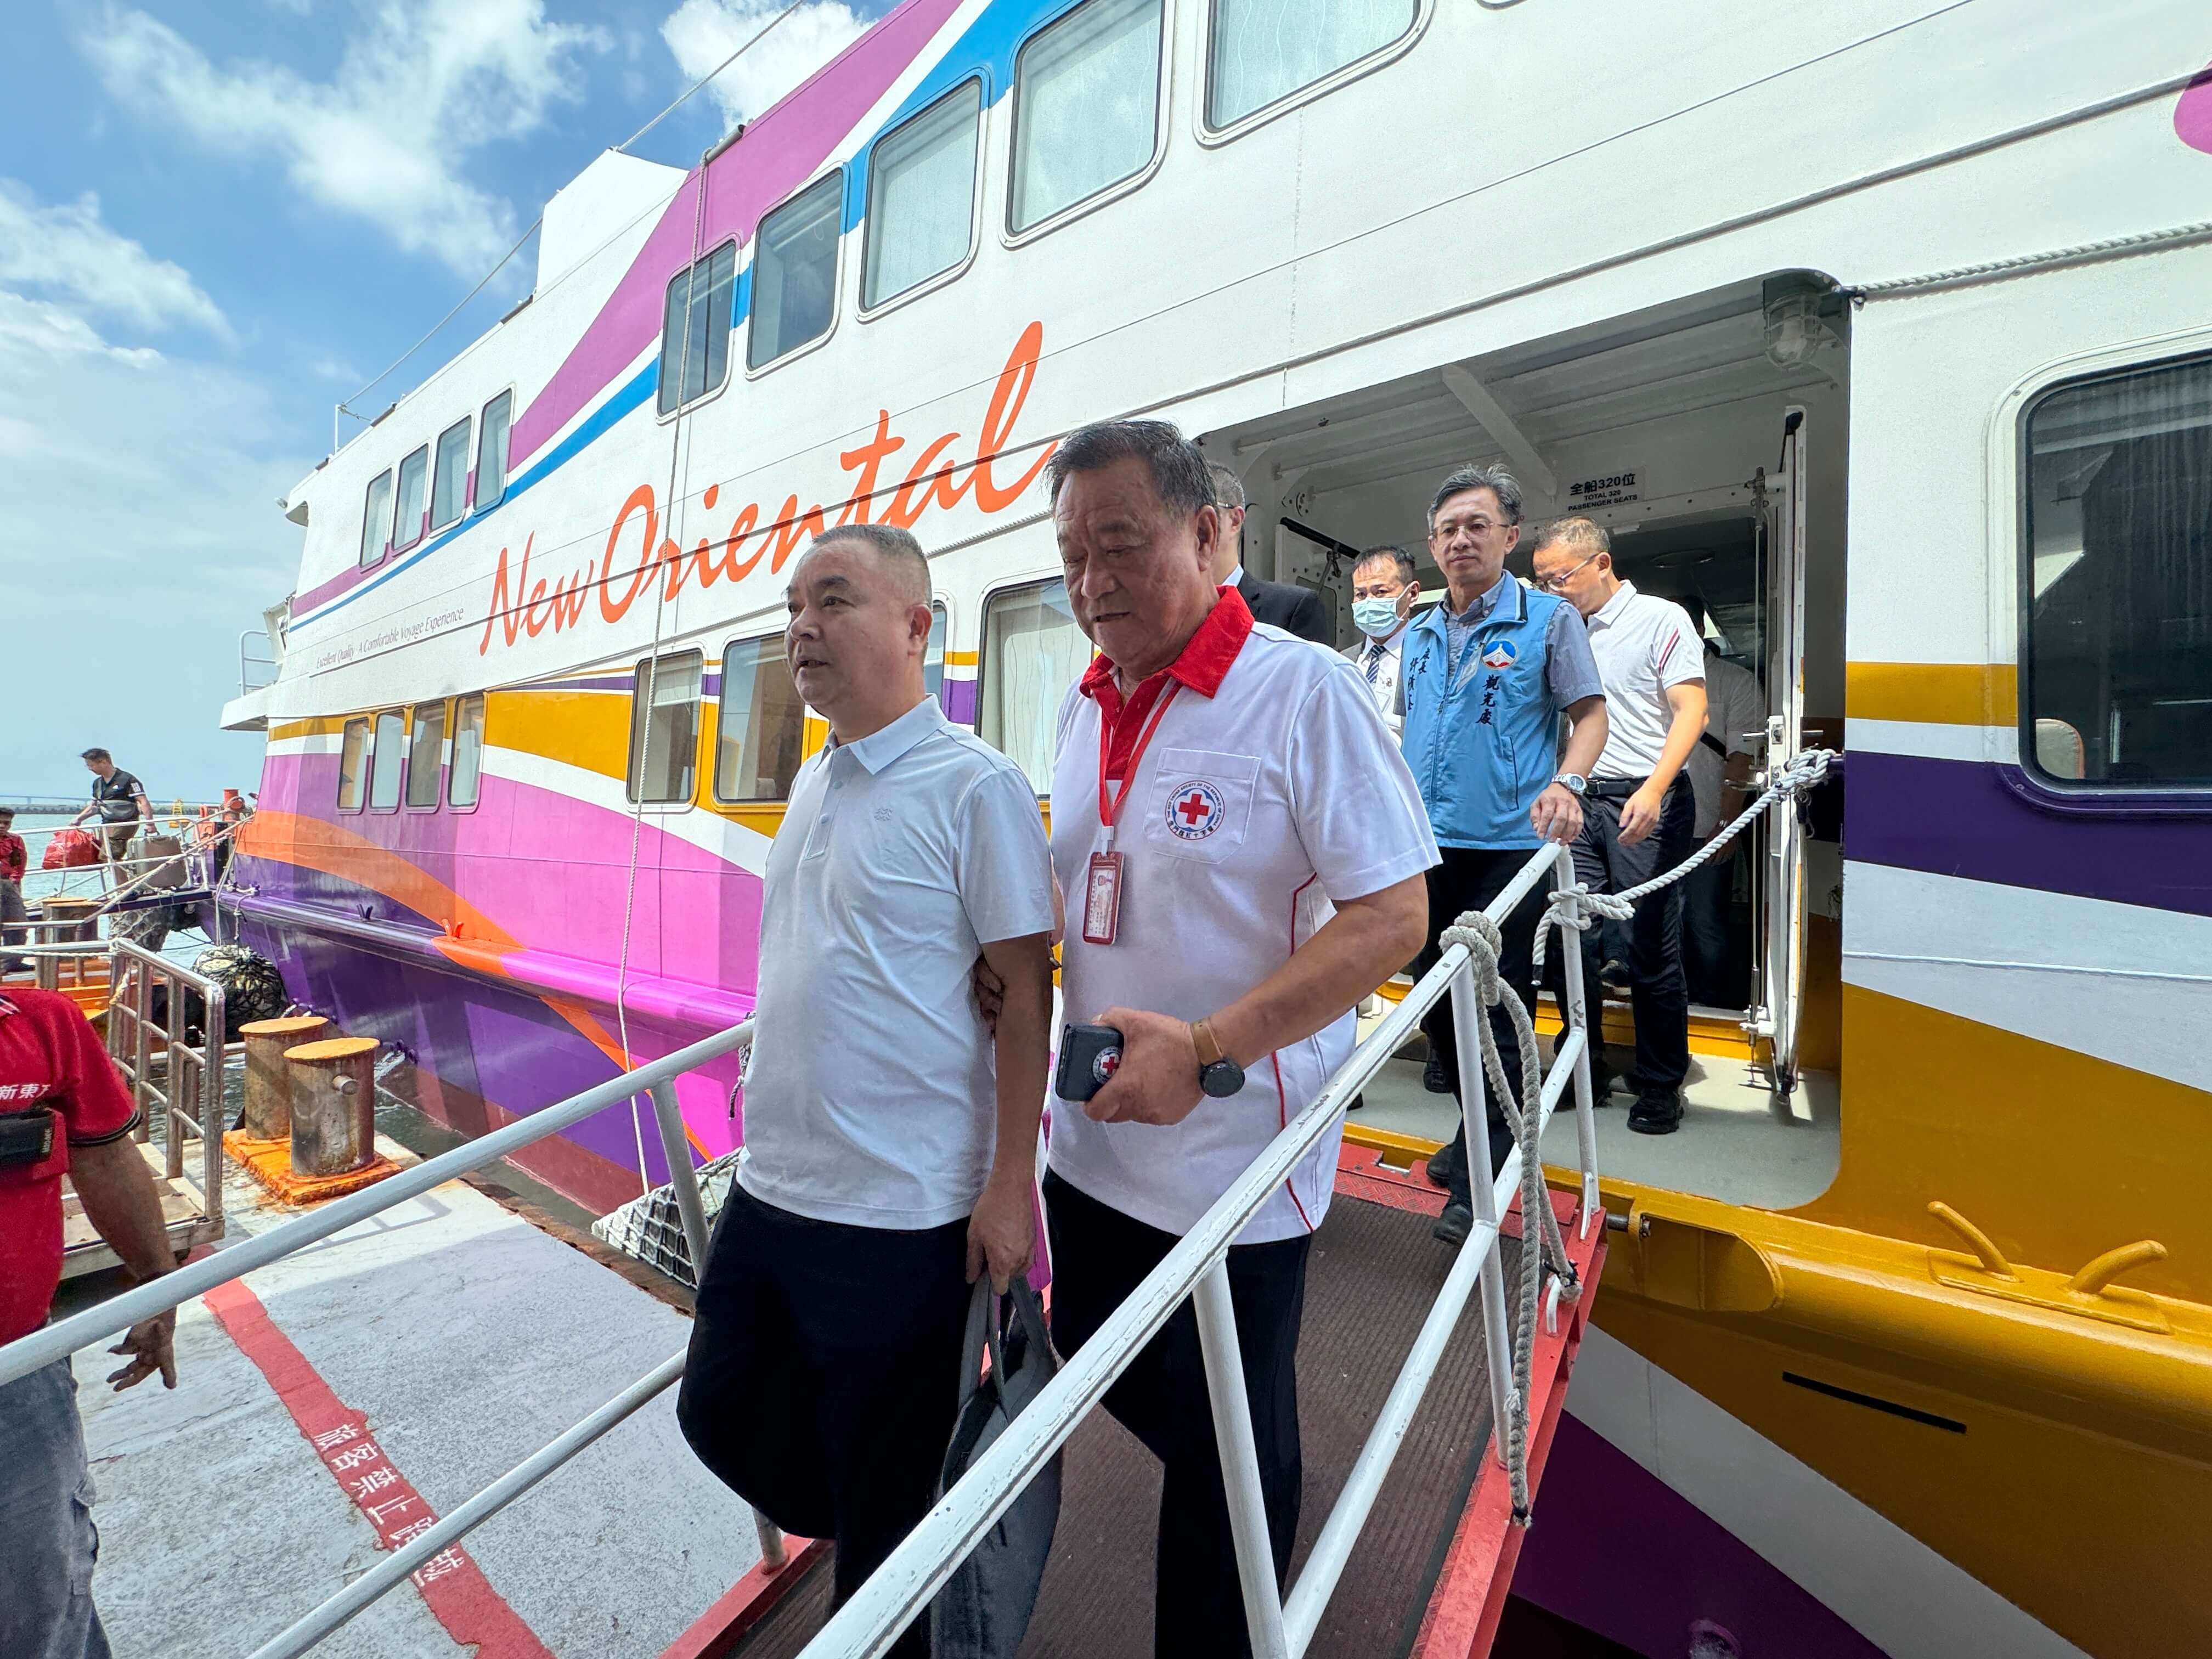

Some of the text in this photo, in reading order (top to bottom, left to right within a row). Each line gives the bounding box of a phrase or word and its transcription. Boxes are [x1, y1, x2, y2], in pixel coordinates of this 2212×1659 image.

[479, 321, 1058, 656] New Oriental
[1568, 494, 1638, 511] PASSENGER SEATS
[1570, 473, 1636, 496] 全船320位
[316, 608, 464, 669] Excellent Quality A Comfortable Voyage Experience
